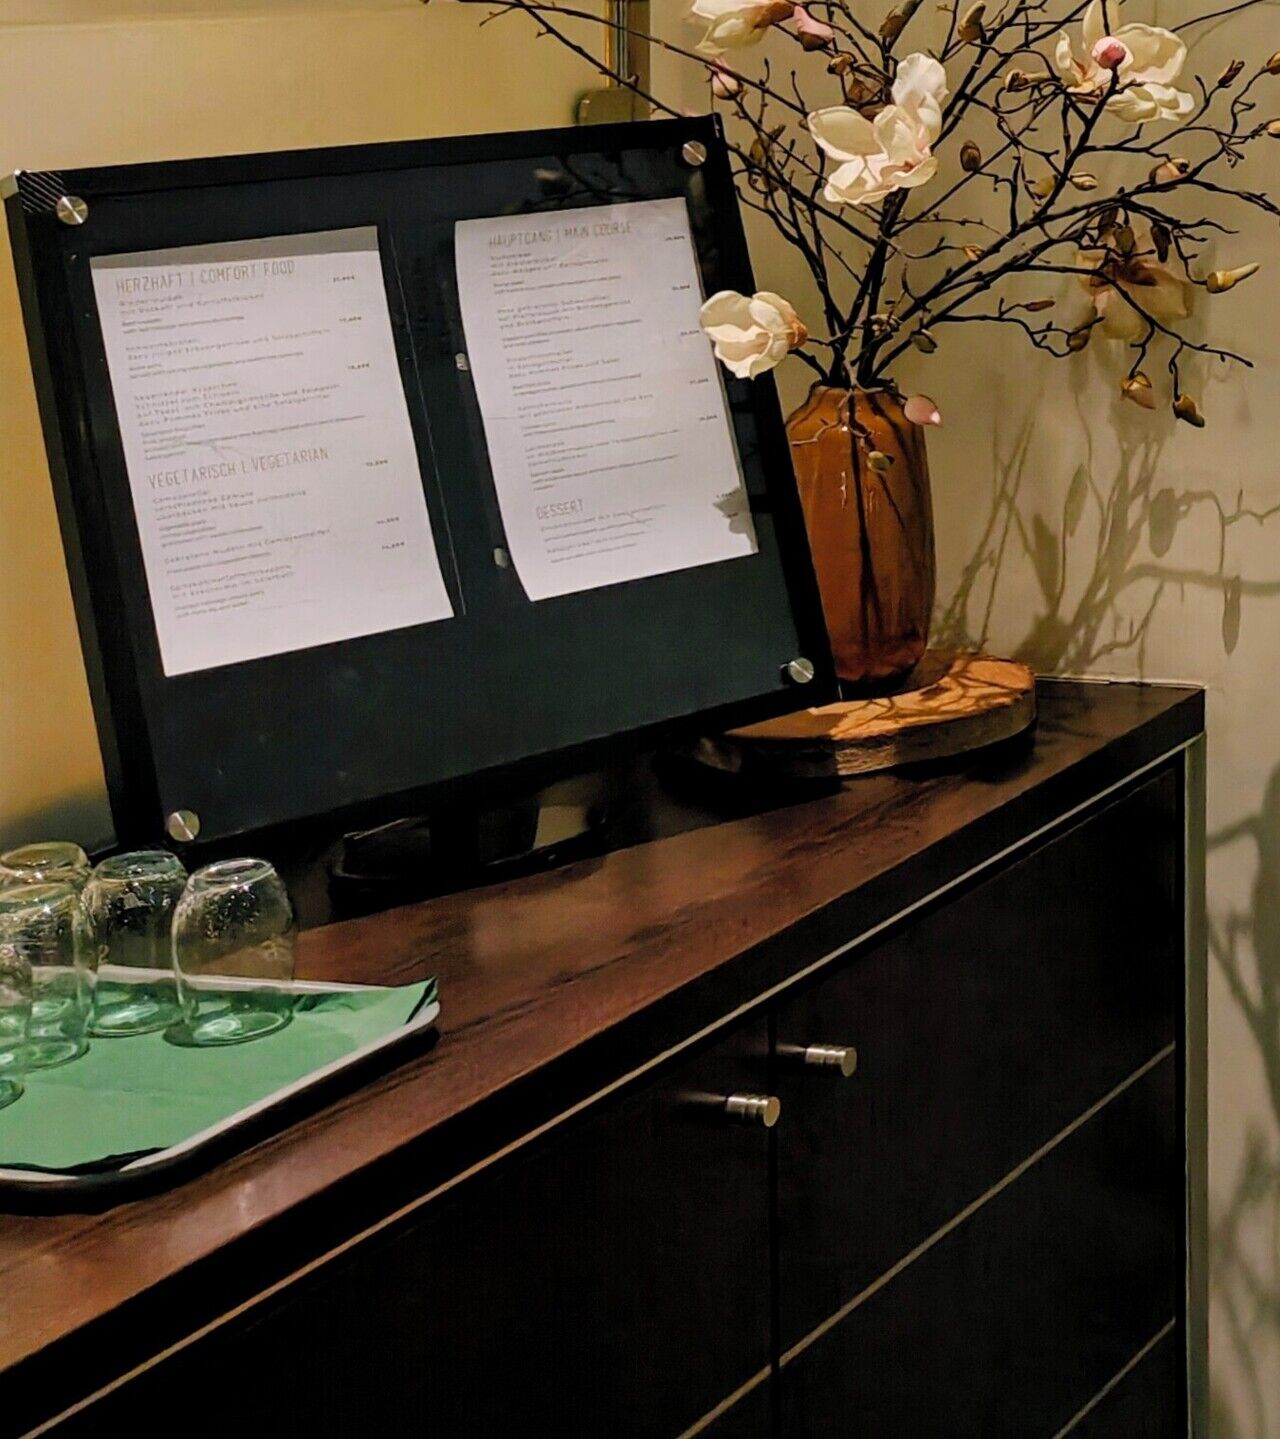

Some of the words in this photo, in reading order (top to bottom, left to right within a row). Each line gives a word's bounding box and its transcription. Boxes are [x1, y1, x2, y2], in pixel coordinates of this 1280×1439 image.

[116, 270, 184, 295] HERZHAFT
[200, 263, 257, 285] COMFORT
[263, 260, 296, 278] FOOD
[148, 461, 236, 490] VEGETARISCH
[251, 447, 329, 473] VEGETARIAN
[535, 498, 585, 521] DESSERT
